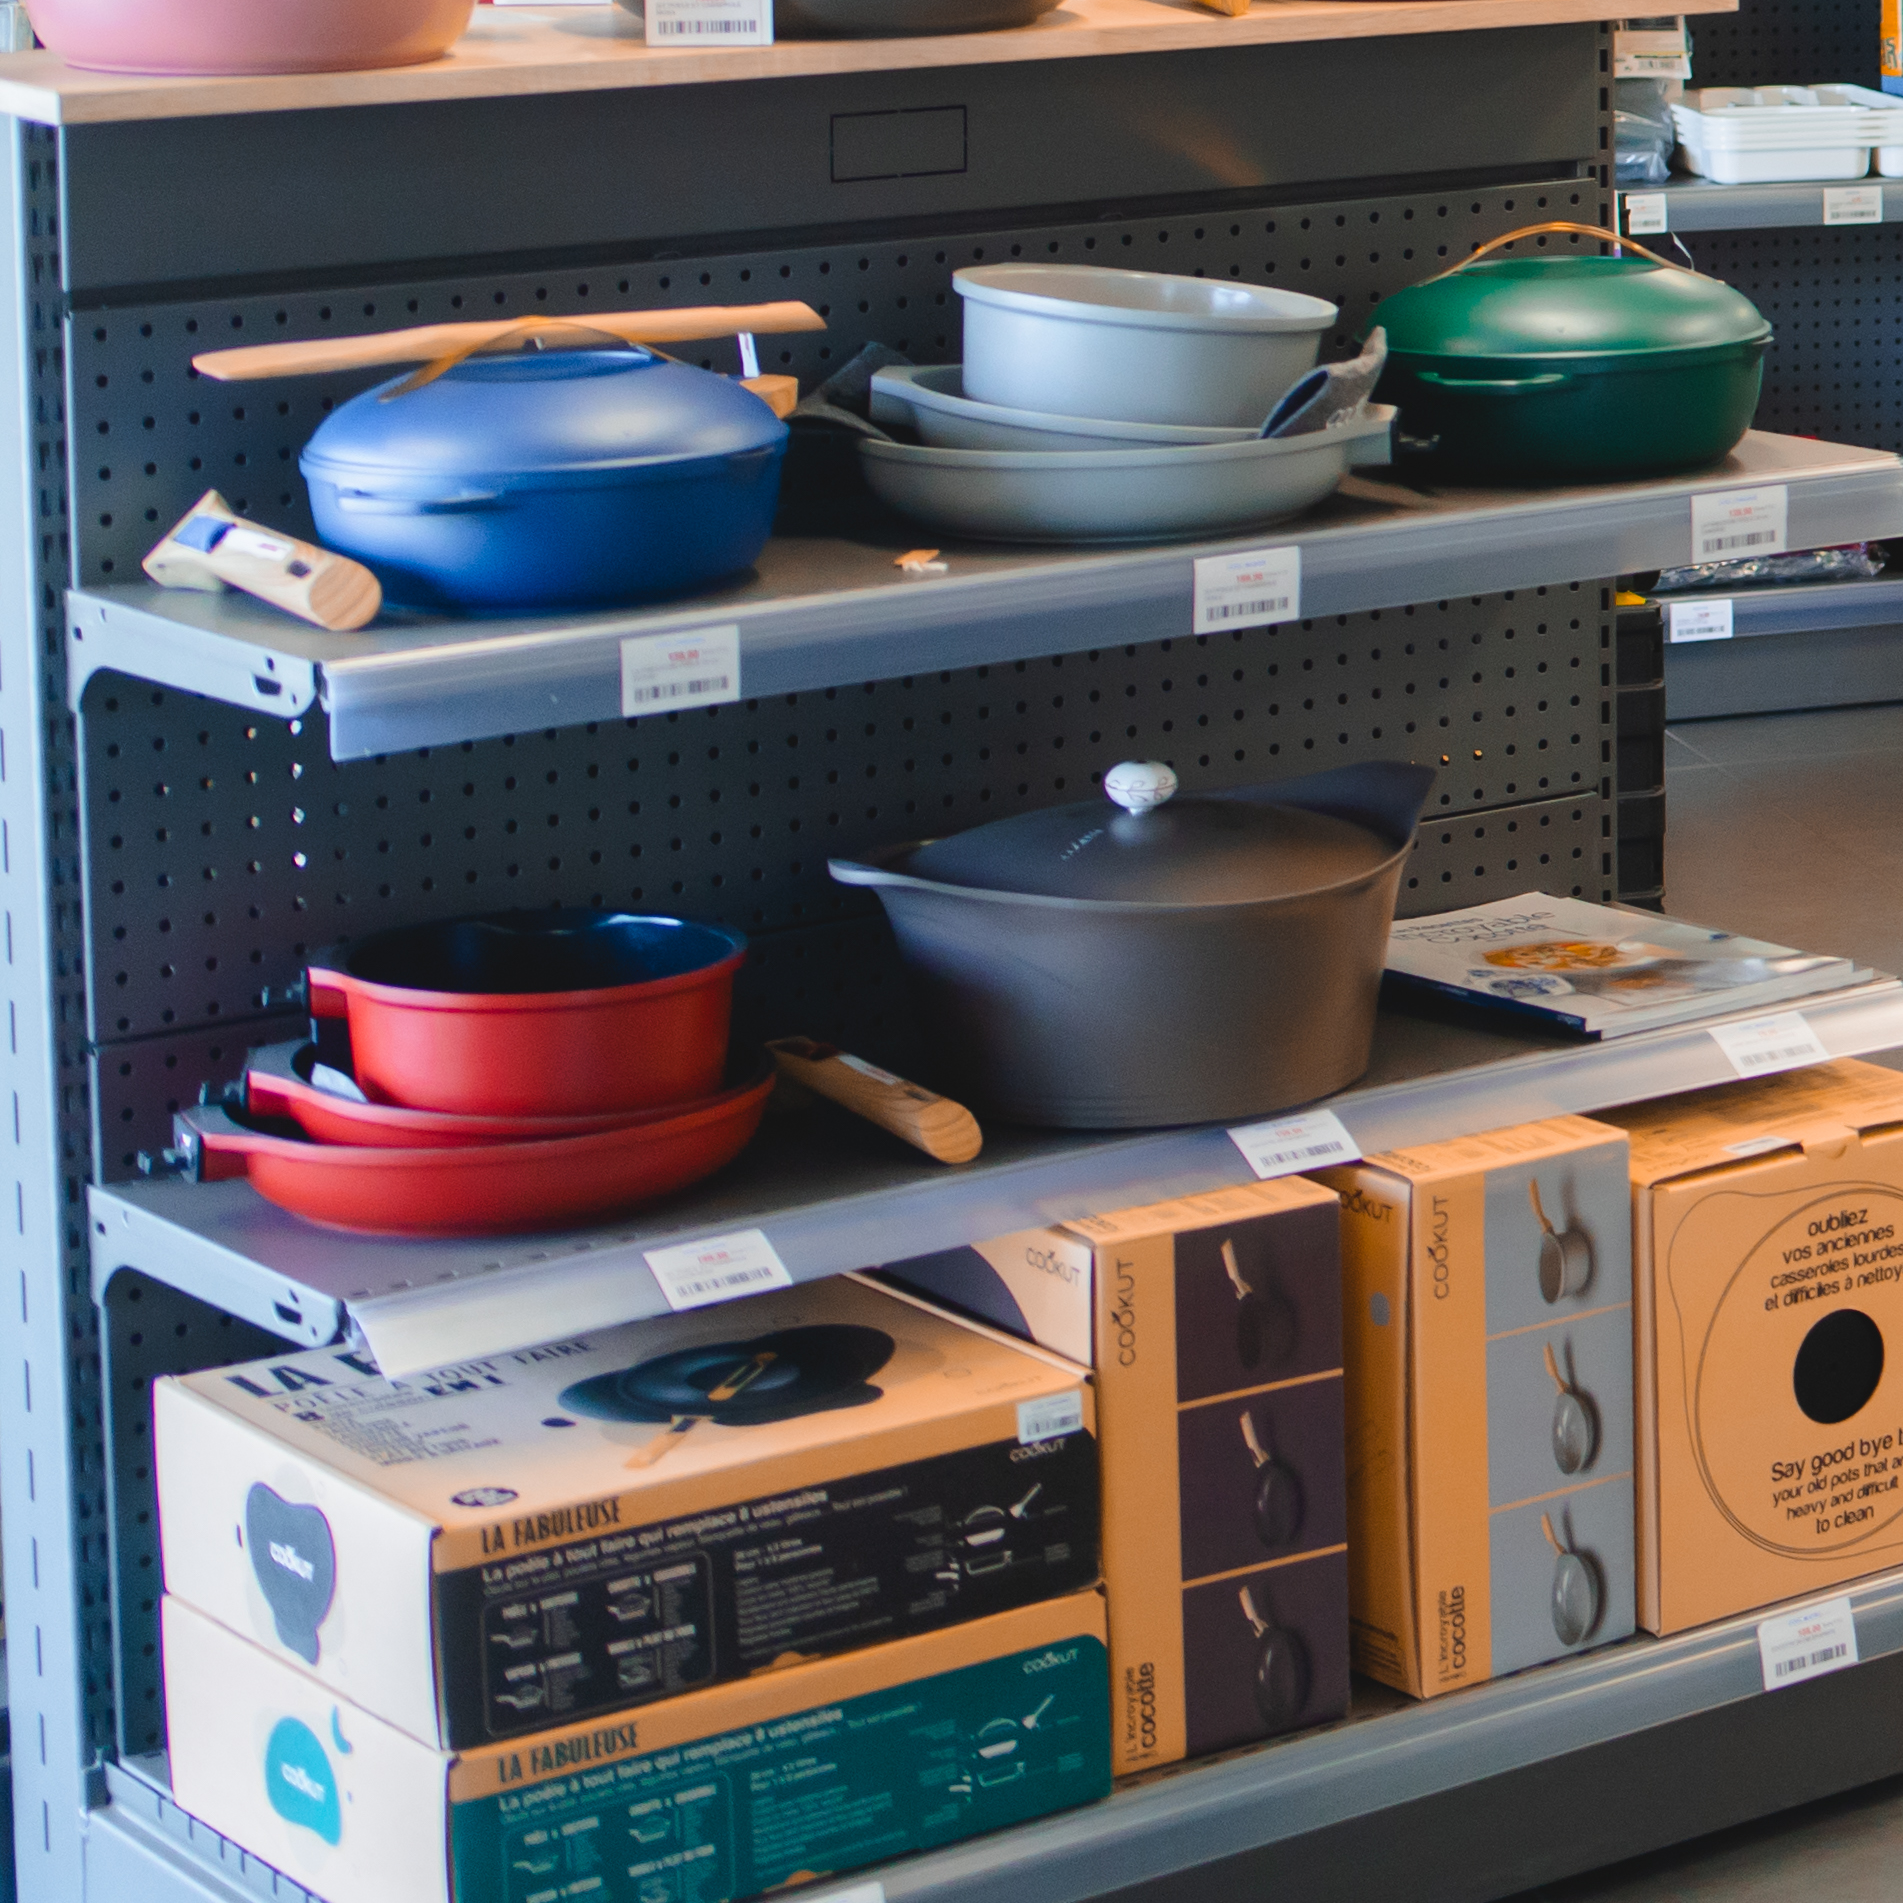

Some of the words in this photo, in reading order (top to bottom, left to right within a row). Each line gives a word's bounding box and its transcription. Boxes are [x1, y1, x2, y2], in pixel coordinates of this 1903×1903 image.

[1781, 1244, 1812, 1265] vos
[1816, 1223, 1896, 1257] anciennes
[1807, 1208, 1870, 1237] oubliez
[1763, 1292, 1780, 1312] et
[1782, 1278, 1841, 1308] difficiles
[1843, 1274, 1854, 1291] à
[1769, 1255, 1850, 1290] casseroles
[1770, 1456, 1807, 1484] Say
[1810, 1440, 1856, 1478] good
[1858, 1431, 1894, 1459] bye
[1771, 1483, 1804, 1509] your
[1806, 1474, 1828, 1495] old
[1830, 1466, 1861, 1493] pots
[1863, 1457, 1890, 1478] that
[1785, 1497, 1827, 1522] heavy
[1830, 1488, 1855, 1509] and
[1856, 1475, 1900, 1502] difficult
[481, 1523, 498, 1557] LA
[513, 1495, 623, 1547] FABULEUSE
[1815, 1517, 1831, 1535] to
[1833, 1504, 1876, 1530] clean
[482, 1562, 504, 1583] La
[565, 1542, 599, 1564] tout
[599, 1533, 637, 1555] faire
[637, 1527, 666, 1550] qui
[666, 1510, 737, 1540] remplace
[497, 1750, 522, 1784] LA
[530, 1722, 638, 1775] FABULEUSE
[498, 1792, 520, 1813] La
[582, 1769, 615, 1791] tout
[616, 1758, 653, 1780] faire
[683, 1731, 754, 1762] remplace
